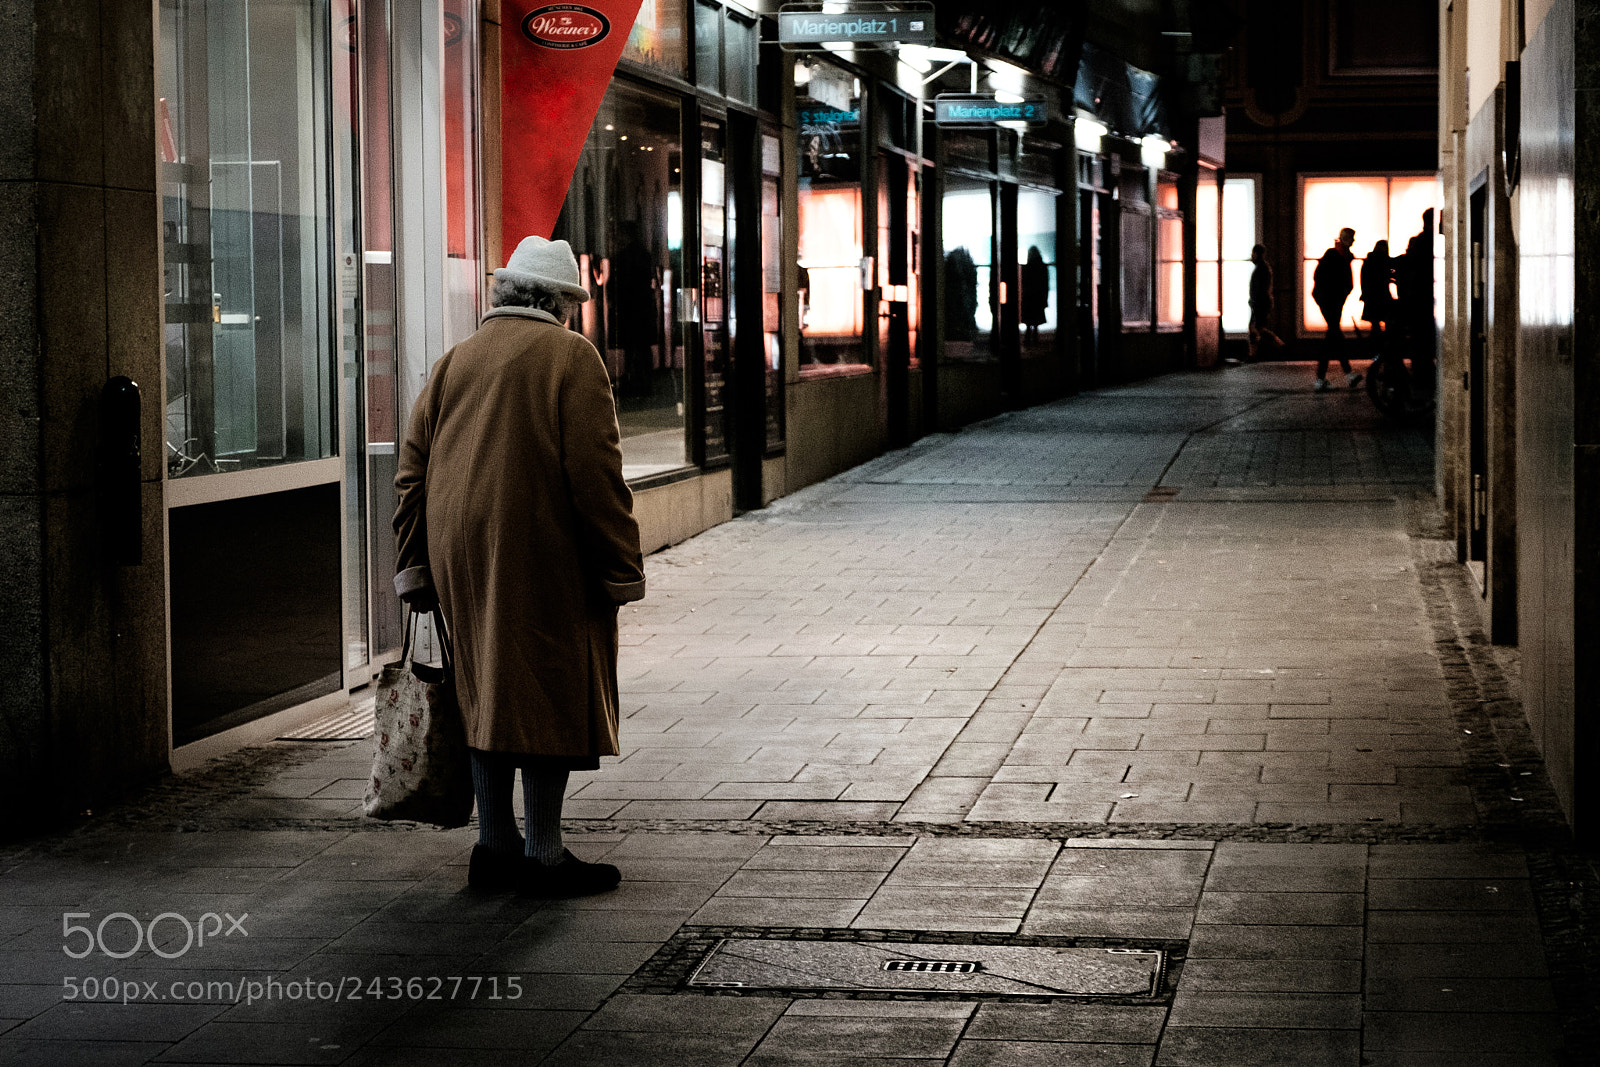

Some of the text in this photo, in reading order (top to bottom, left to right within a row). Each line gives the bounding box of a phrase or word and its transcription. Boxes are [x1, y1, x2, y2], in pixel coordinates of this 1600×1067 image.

[532, 17, 598, 35] Woerner's
[793, 18, 887, 37] Marienplatz
[890, 18, 897, 32] 1
[948, 105, 1034, 119] Marienplatz 2
